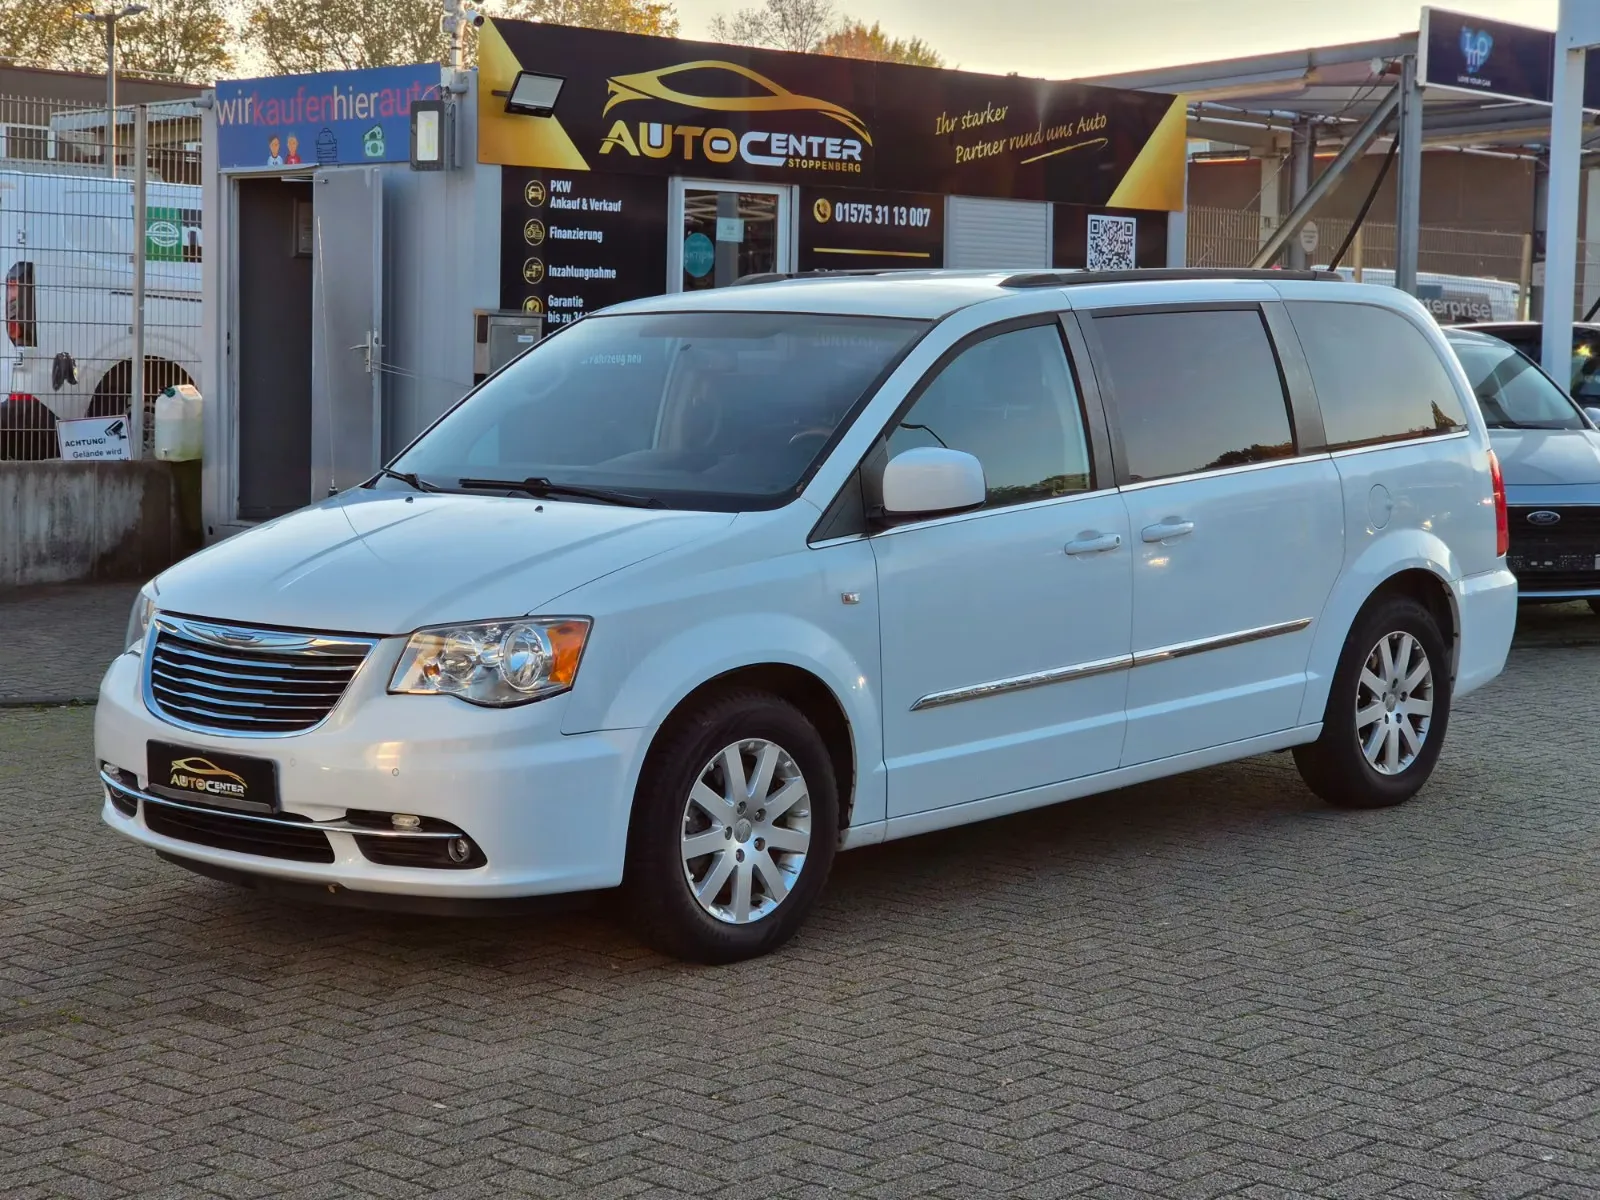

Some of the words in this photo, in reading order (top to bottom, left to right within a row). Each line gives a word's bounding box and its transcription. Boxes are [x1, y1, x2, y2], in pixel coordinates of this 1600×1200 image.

[935, 111, 958, 135] Ihr
[961, 101, 1009, 130] starker
[955, 138, 1007, 164] Partner
[1009, 121, 1045, 151] rund
[1046, 122, 1073, 141] ums
[1076, 112, 1107, 134] Auto
[788, 157, 861, 173] STOPPENBERG
[550, 179, 572, 193] PKW
[550, 195, 580, 210] Ankauf
[581, 197, 588, 210] &
[589, 198, 622, 212] Verkauf
[835, 202, 873, 224] 01575
[875, 204, 889, 225] 31
[893, 206, 907, 226] 13
[909, 207, 931, 227] 007
[549, 225, 603, 243] Finanzierung
[548, 264, 617, 281] Inzahlungnahme
[547, 294, 584, 308] Garantie
[547, 310, 561, 323] bis
[562, 313, 571, 323] zu
[65, 437, 106, 447] ACHTUNG!
[105, 448, 122, 456] wird
